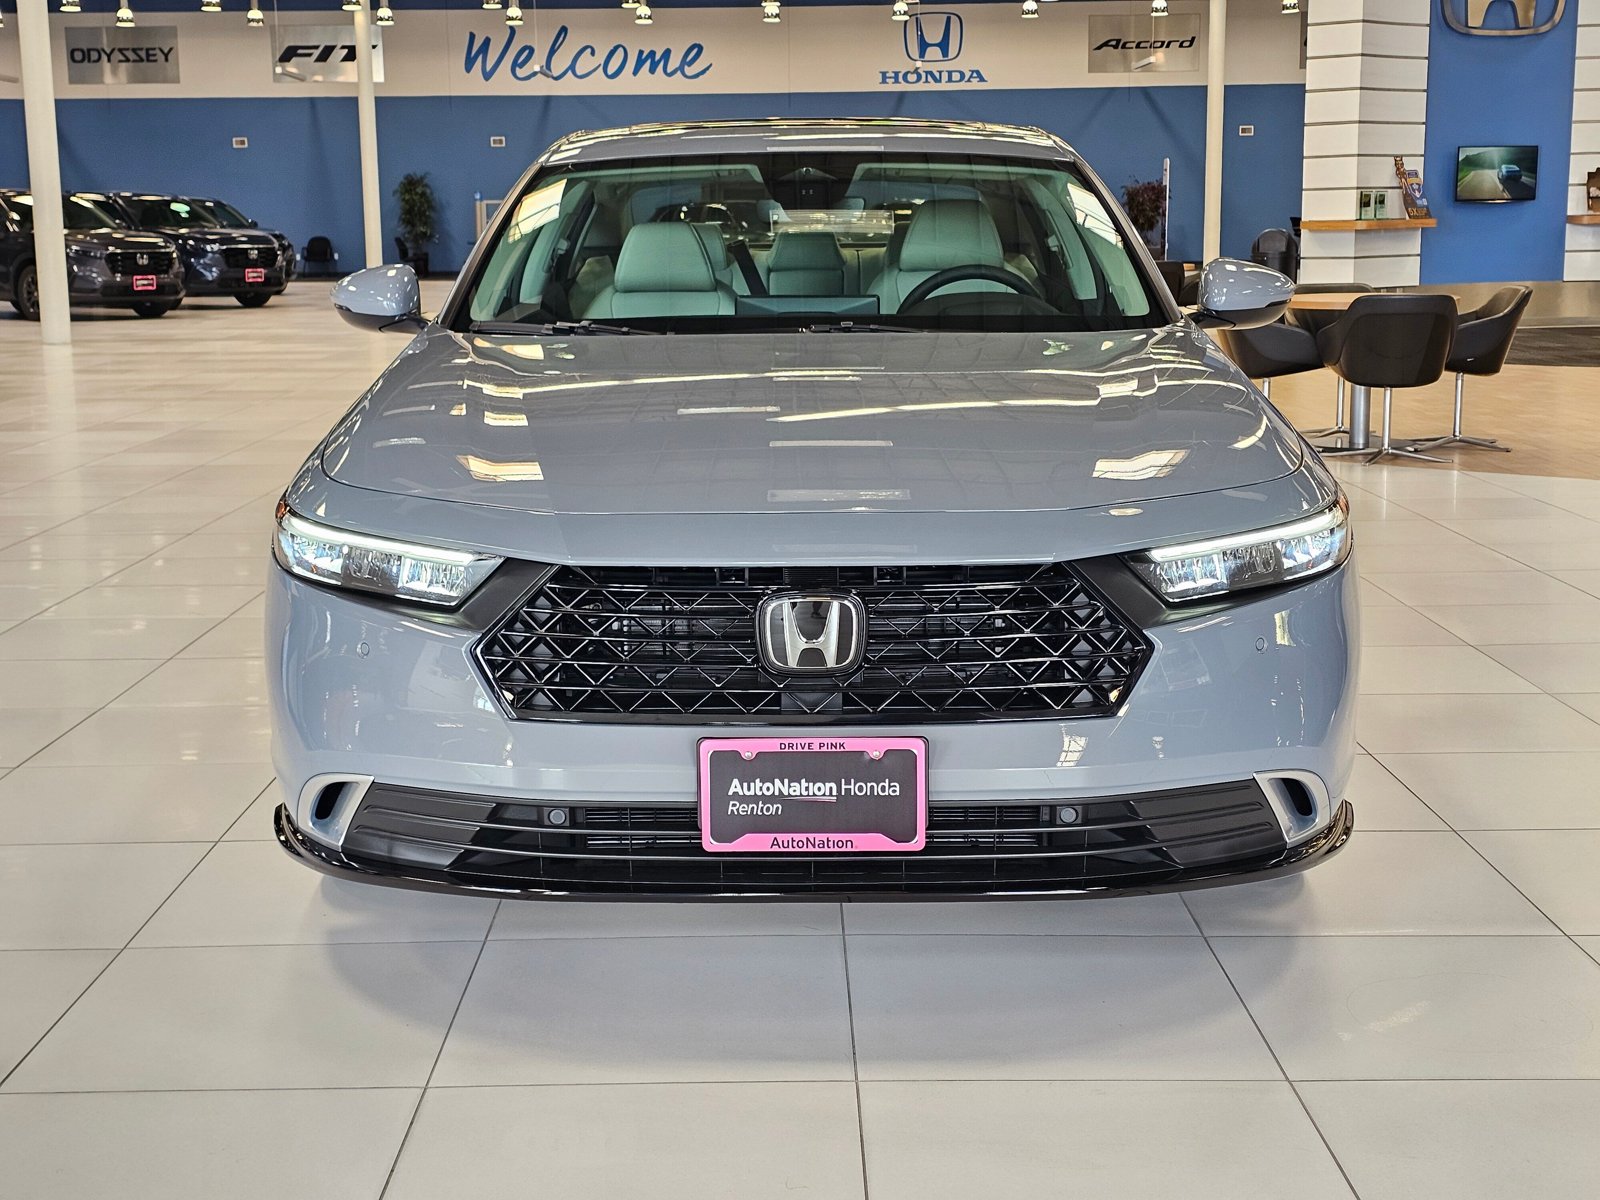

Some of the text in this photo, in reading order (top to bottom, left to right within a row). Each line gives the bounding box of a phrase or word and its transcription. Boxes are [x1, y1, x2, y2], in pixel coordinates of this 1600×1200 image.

[1092, 36, 1196, 51] Accord
[70, 46, 174, 63] ODYSSEY
[464, 25, 713, 82] Welcome
[879, 69, 988, 84] HONDA
[779, 741, 846, 750] DRIVE PINK
[728, 778, 900, 796] AutoNation Honda
[728, 801, 782, 815] Renton
[770, 836, 854, 849] AutoNation
